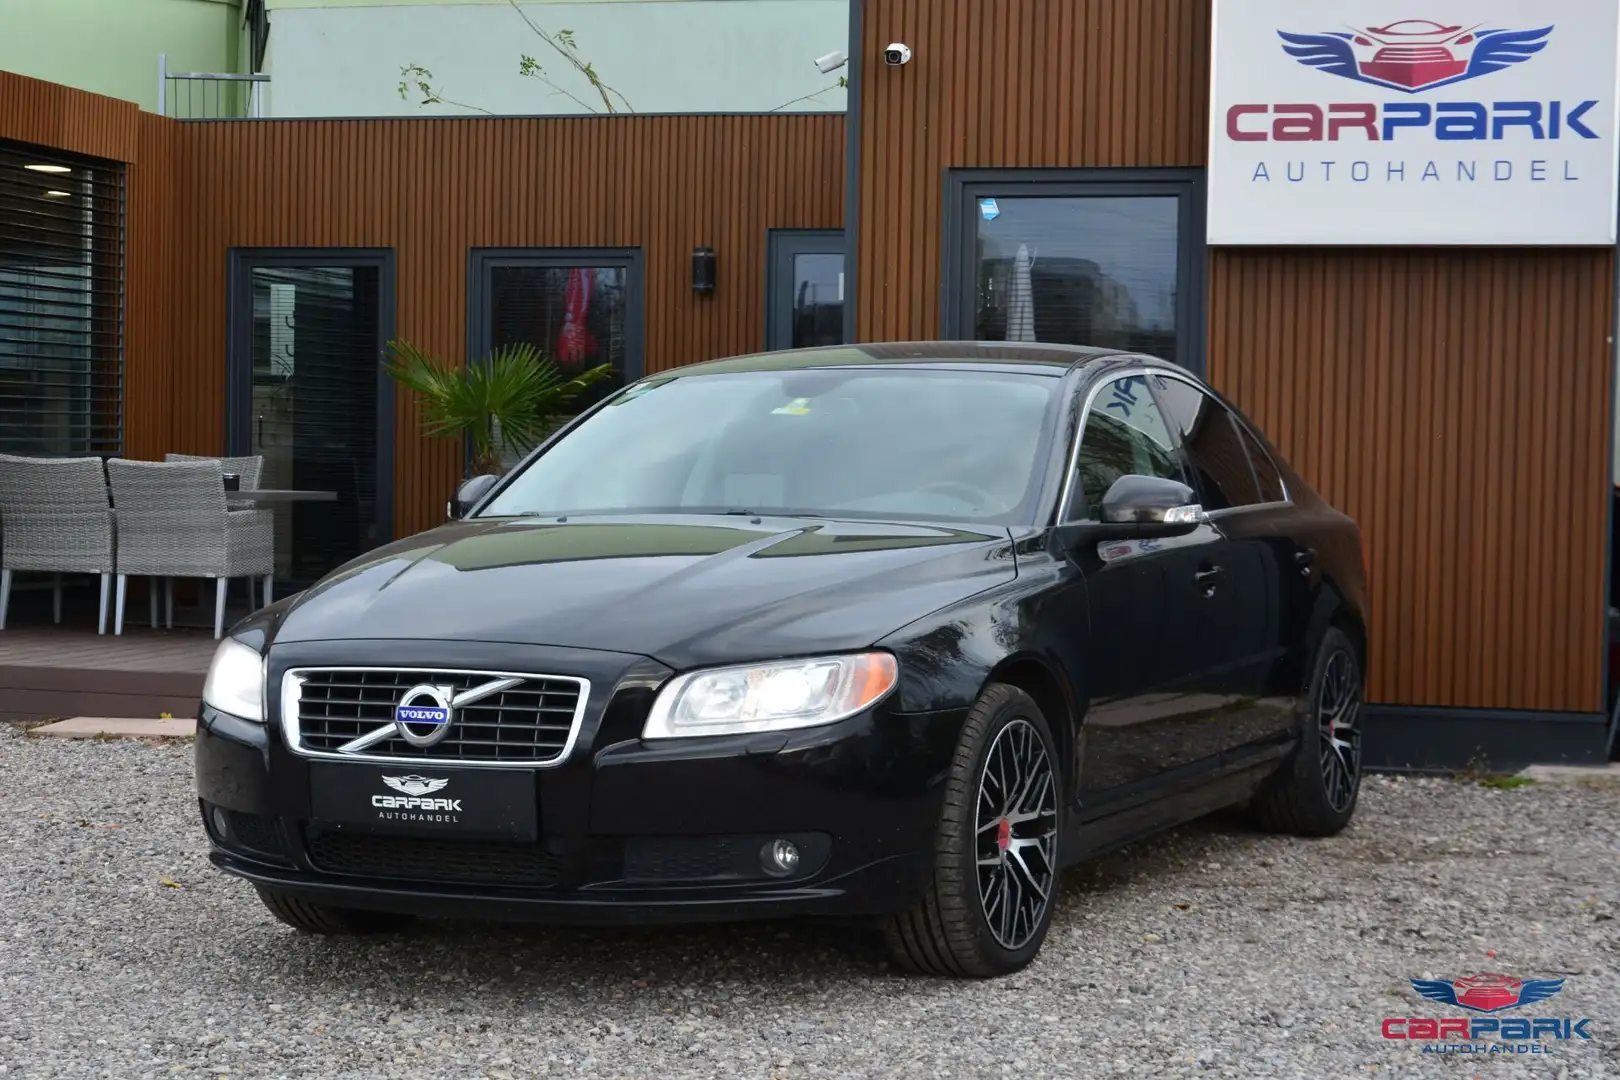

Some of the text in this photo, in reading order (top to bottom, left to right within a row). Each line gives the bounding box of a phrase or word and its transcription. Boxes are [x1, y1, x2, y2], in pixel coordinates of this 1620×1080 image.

[1251, 160, 1579, 182] AUTOHANDEL
[399, 709, 445, 720] VOLVO
[378, 811, 459, 823] AUTOHANDEL
